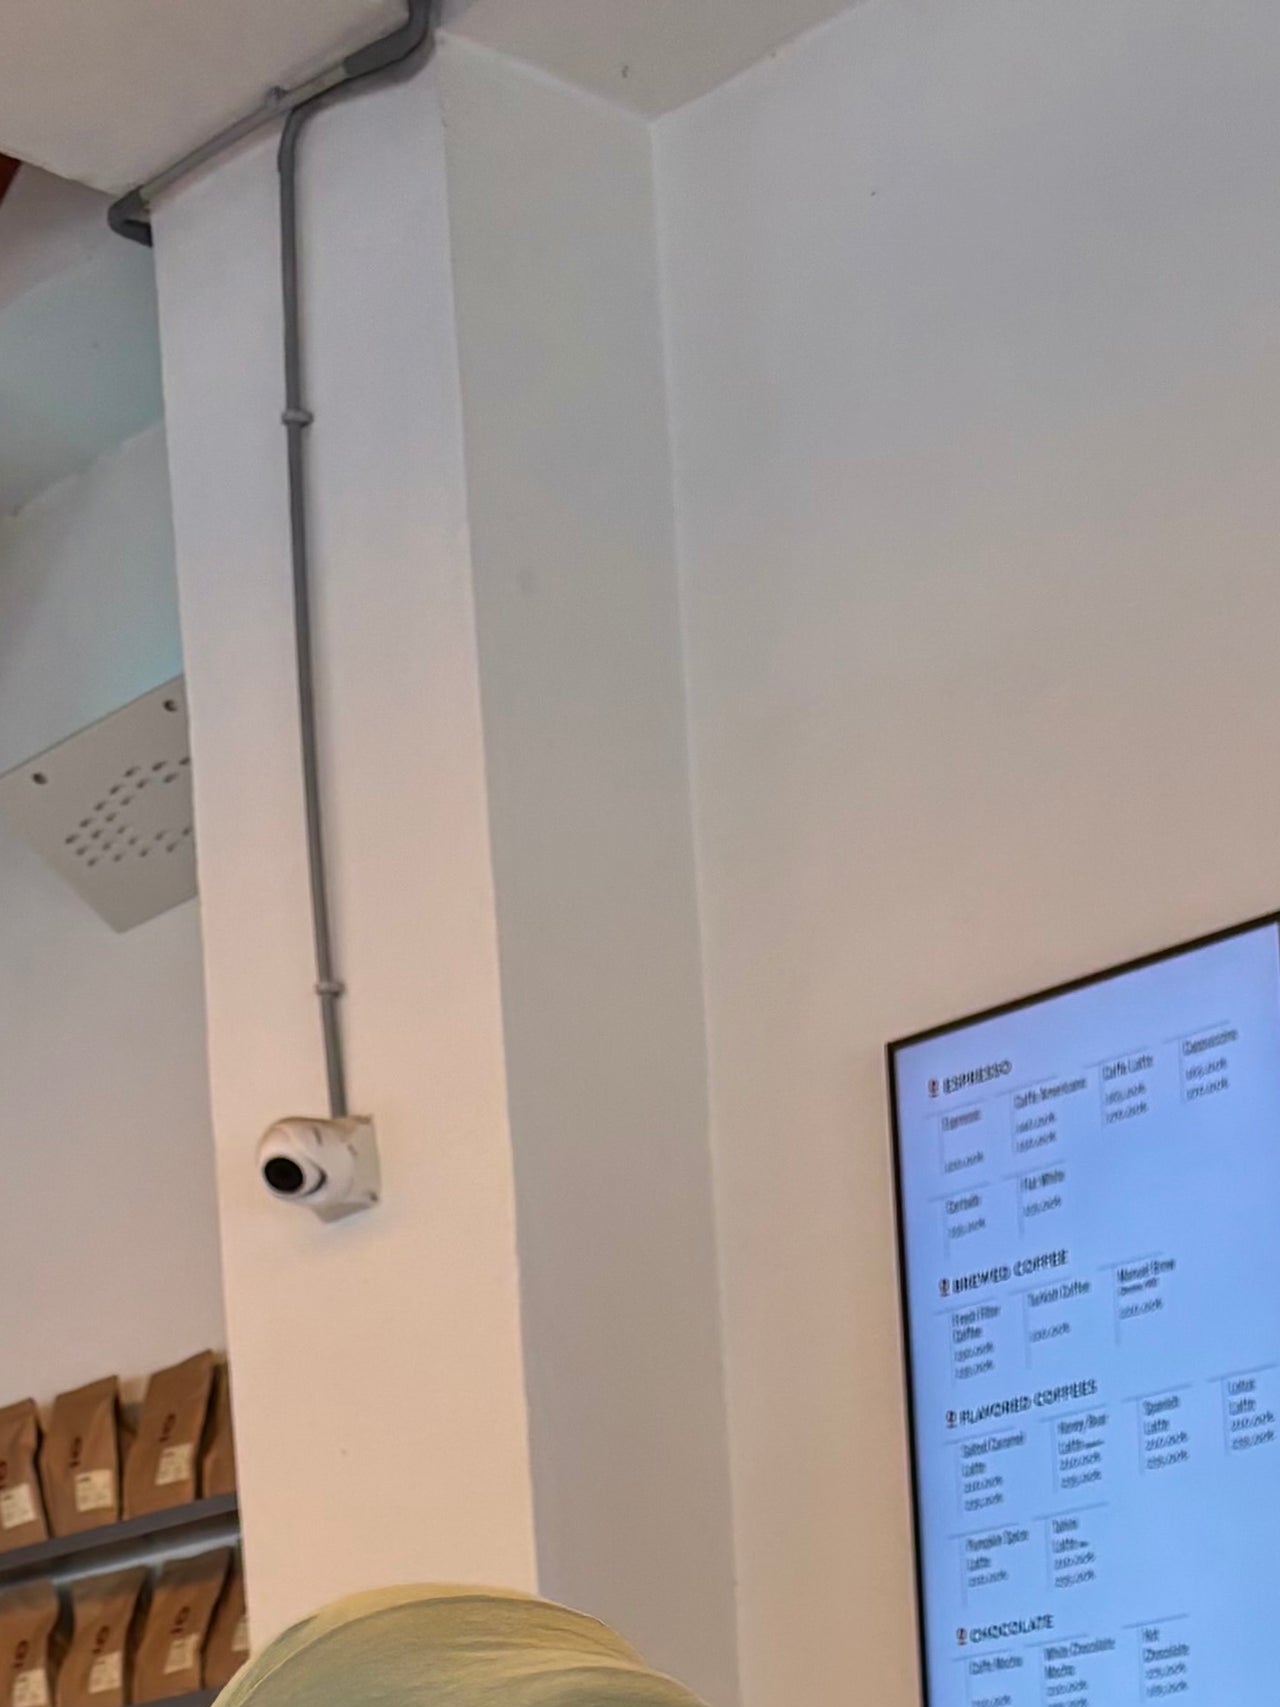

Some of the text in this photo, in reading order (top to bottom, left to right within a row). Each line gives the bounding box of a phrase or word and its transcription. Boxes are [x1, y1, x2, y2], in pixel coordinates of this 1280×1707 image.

[943, 1060, 1013, 1096] ESPRESSO
[952, 1249, 1068, 1294] BREWED COFFEE
[958, 1379, 1098, 1425] FLAVORED COFFEES
[969, 1615, 1054, 1643] CHOCOLATE
